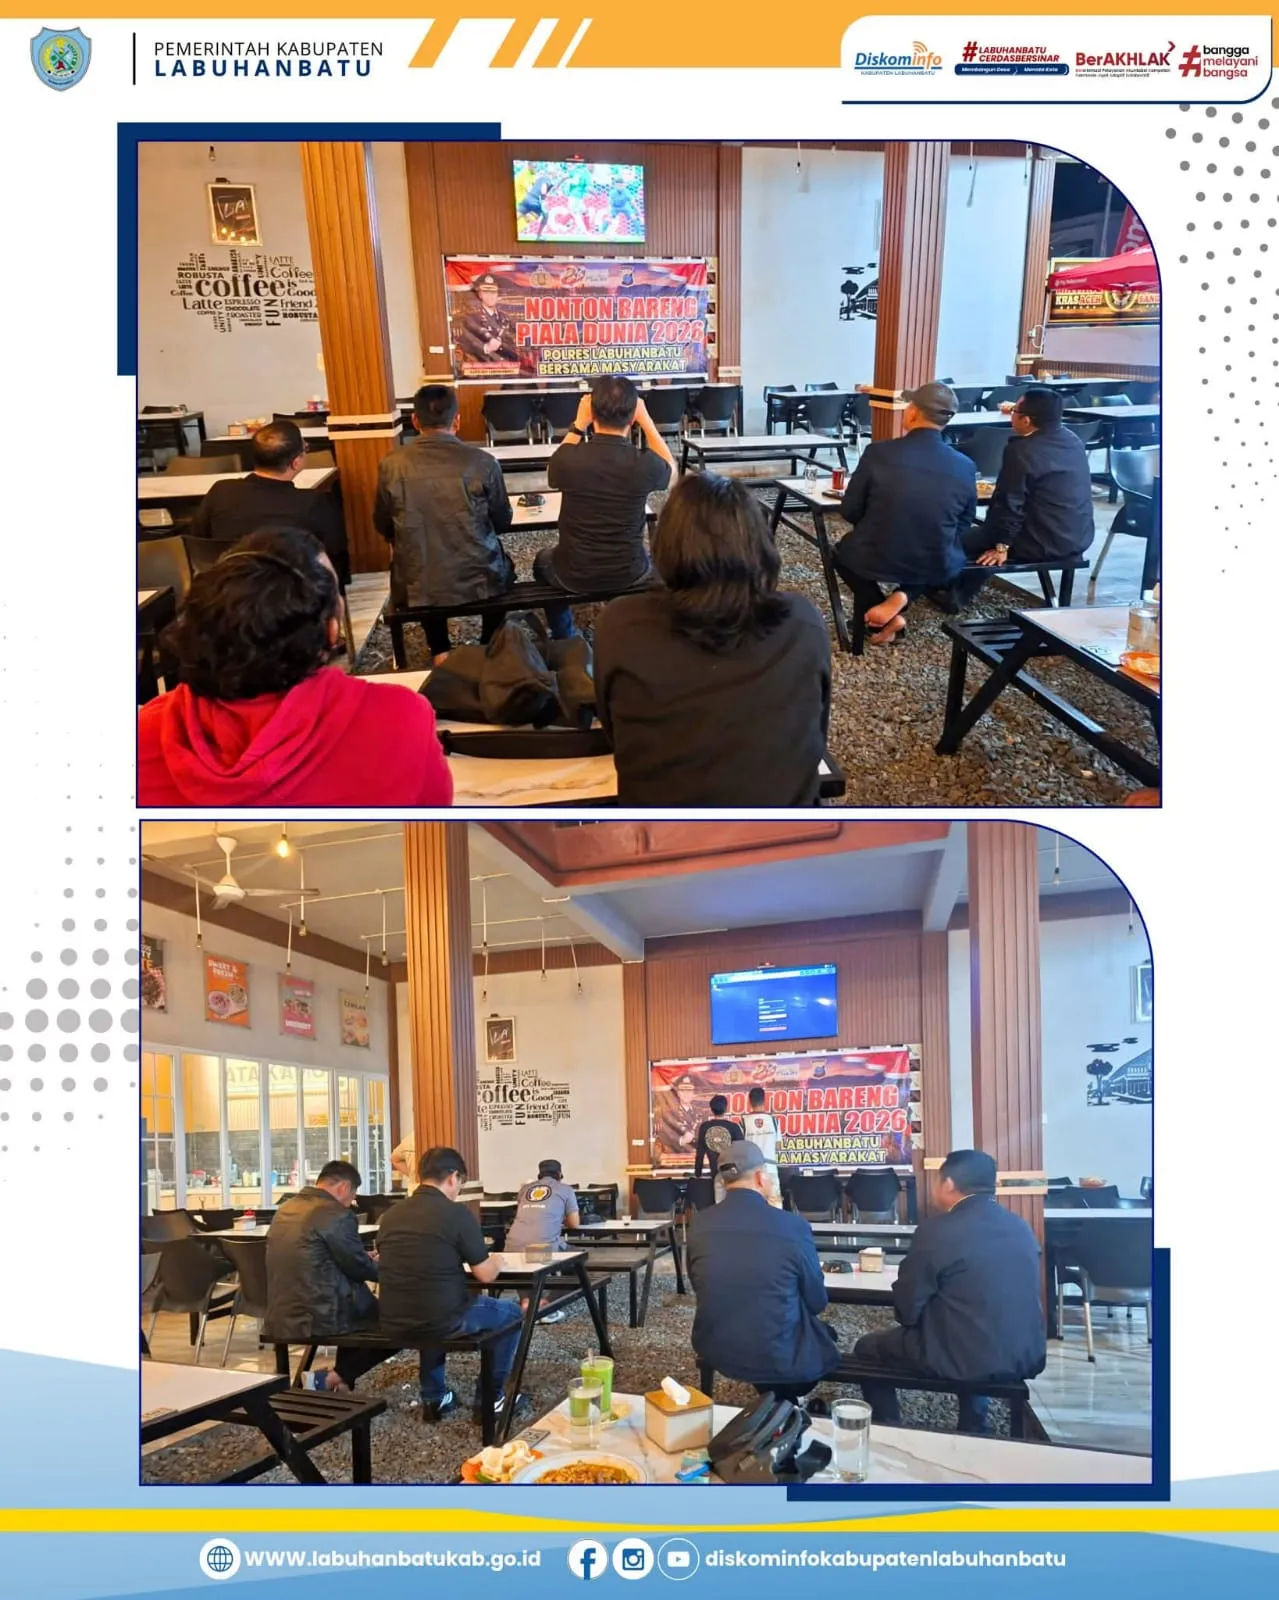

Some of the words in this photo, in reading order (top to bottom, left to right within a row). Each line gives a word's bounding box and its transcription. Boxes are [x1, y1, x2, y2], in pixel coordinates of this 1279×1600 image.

[195, 273, 286, 298] coffee
[183, 297, 223, 310] Latte
[264, 299, 281, 326] FUN
[524, 296, 614, 321] NONTON
[617, 296, 698, 320] BARENG
[515, 322, 581, 347] PIALA
[582, 321, 649, 346] DUNIA
[651, 320, 706, 344] 2026
[543, 348, 590, 361] POLRES
[591, 347, 682, 360] LABUHANBATU
[538, 362, 600, 375] BERSAMA
[601, 359, 687, 374] MASYARAKAT
[477, 1084, 531, 1104] offee
[807, 1085, 899, 1111] BARENG
[844, 1108, 908, 1134] 2026
[780, 1137, 880, 1150] LABUHANBATU
[790, 1150, 886, 1164] MASYARAKAT
